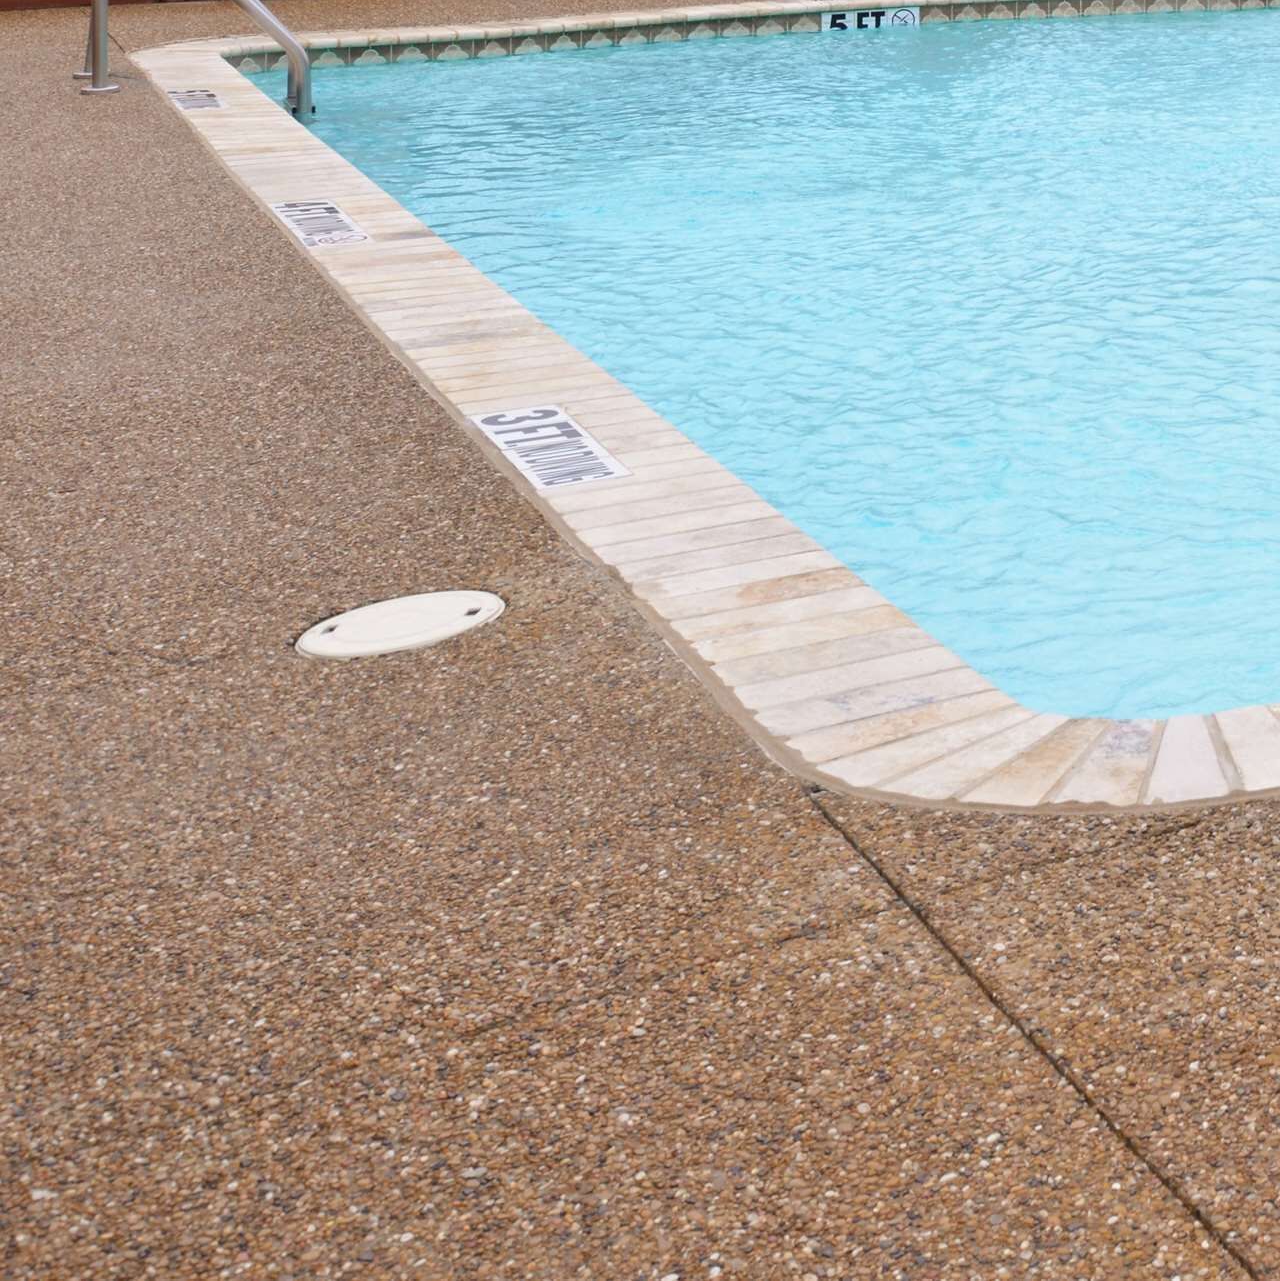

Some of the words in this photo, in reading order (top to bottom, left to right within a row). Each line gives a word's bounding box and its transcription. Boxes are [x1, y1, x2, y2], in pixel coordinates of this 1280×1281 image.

[830, 13, 848, 30] 5
[857, 11, 885, 29] FT
[481, 409, 559, 426] 3
